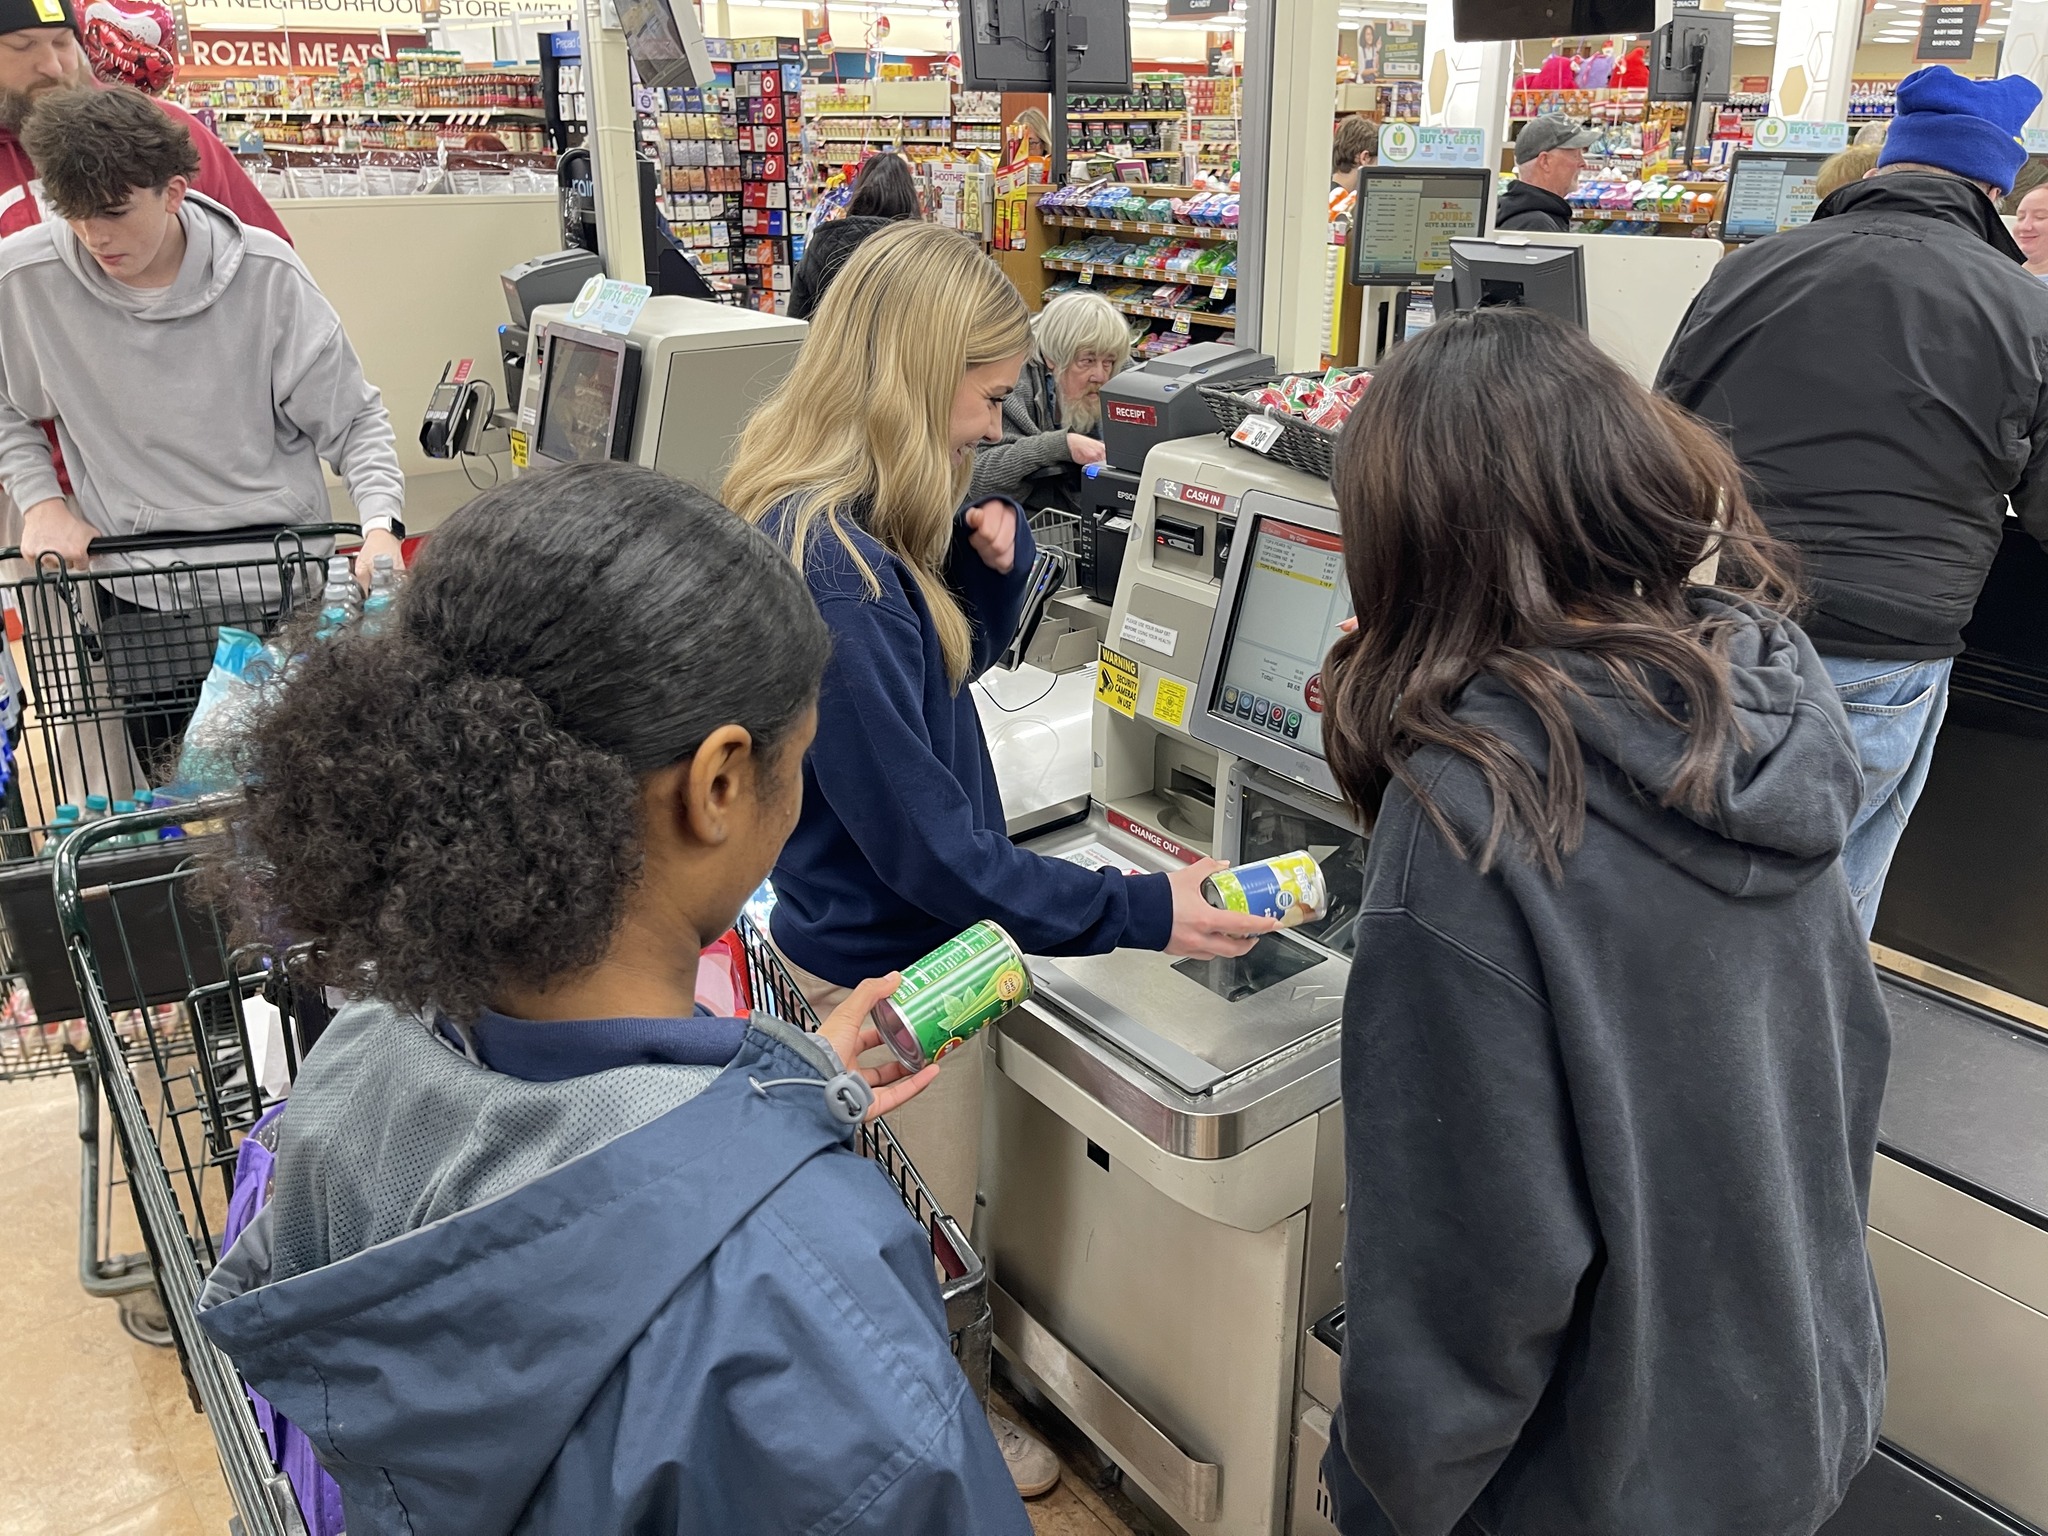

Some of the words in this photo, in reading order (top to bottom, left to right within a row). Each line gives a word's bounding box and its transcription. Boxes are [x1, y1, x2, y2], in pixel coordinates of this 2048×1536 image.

[439, 0, 512, 17] STORE
[299, 42, 386, 67] MEATS
[1789, 126, 1806, 134] BUY
[1419, 134, 1436, 144] BUY
[1453, 135, 1469, 144] GET
[1429, 211, 1473, 221] DOUBLE
[1115, 407, 1146, 420] RECEIPT
[1185, 488, 1209, 503] CASH
[1209, 495, 1220, 506] IN
[1102, 647, 1137, 675] WARNING
[1116, 673, 1138, 692] SECURITY
[1114, 684, 1137, 701] CAMERAS
[1116, 695, 1123, 706] IN
[1122, 698, 1132, 710] USE
[1129, 823, 1162, 847] CHANGE
[1162, 840, 1180, 855] OUT
[1003, 980, 1012, 995] NON
[1008, 976, 1017, 992] GMO
